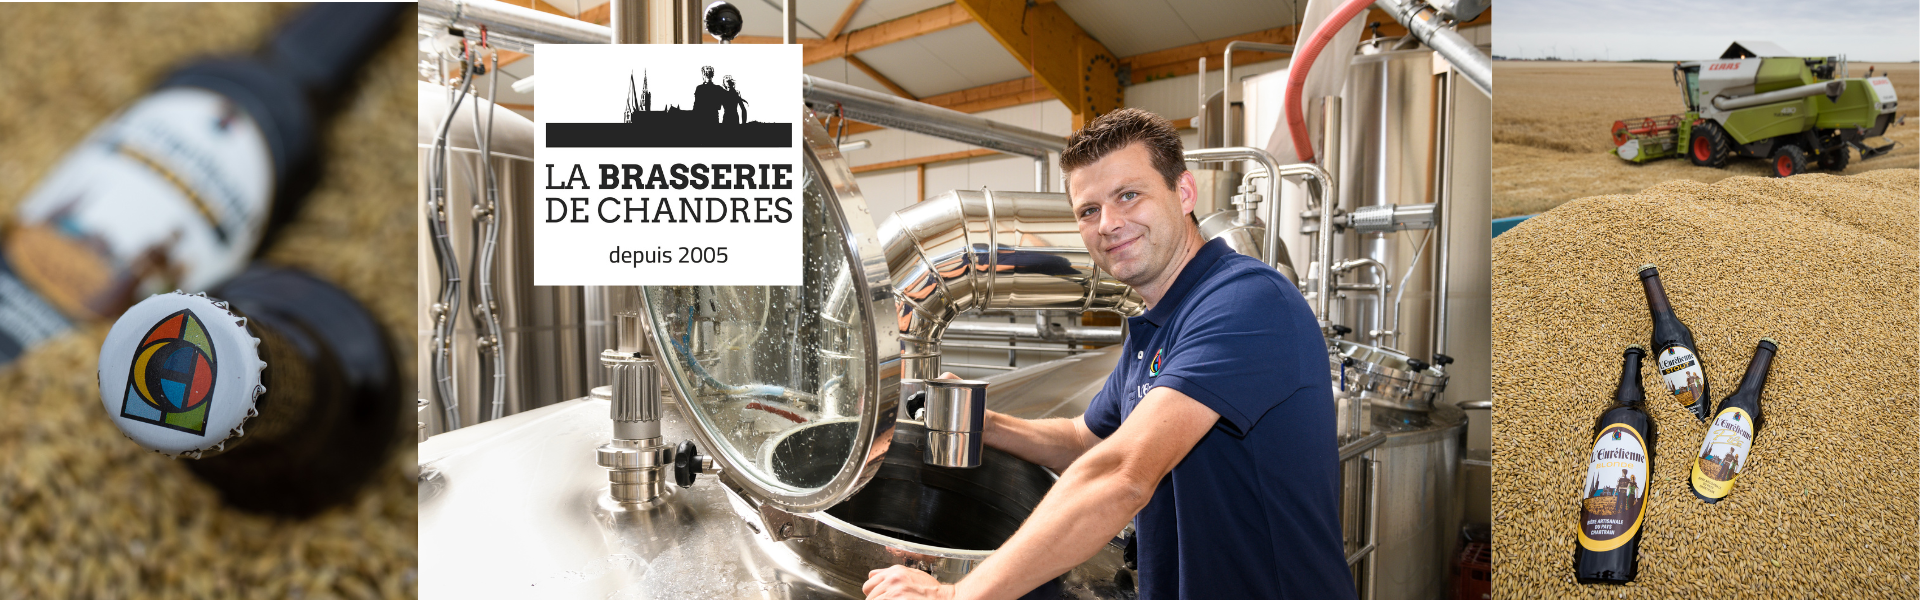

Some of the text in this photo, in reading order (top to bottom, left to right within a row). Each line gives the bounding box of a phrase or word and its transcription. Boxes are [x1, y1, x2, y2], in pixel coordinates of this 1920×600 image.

[1708, 62, 1741, 71] CLAAS
[1665, 361, 1690, 374] STOUT
[1590, 448, 1645, 463] L'Eurélienne
